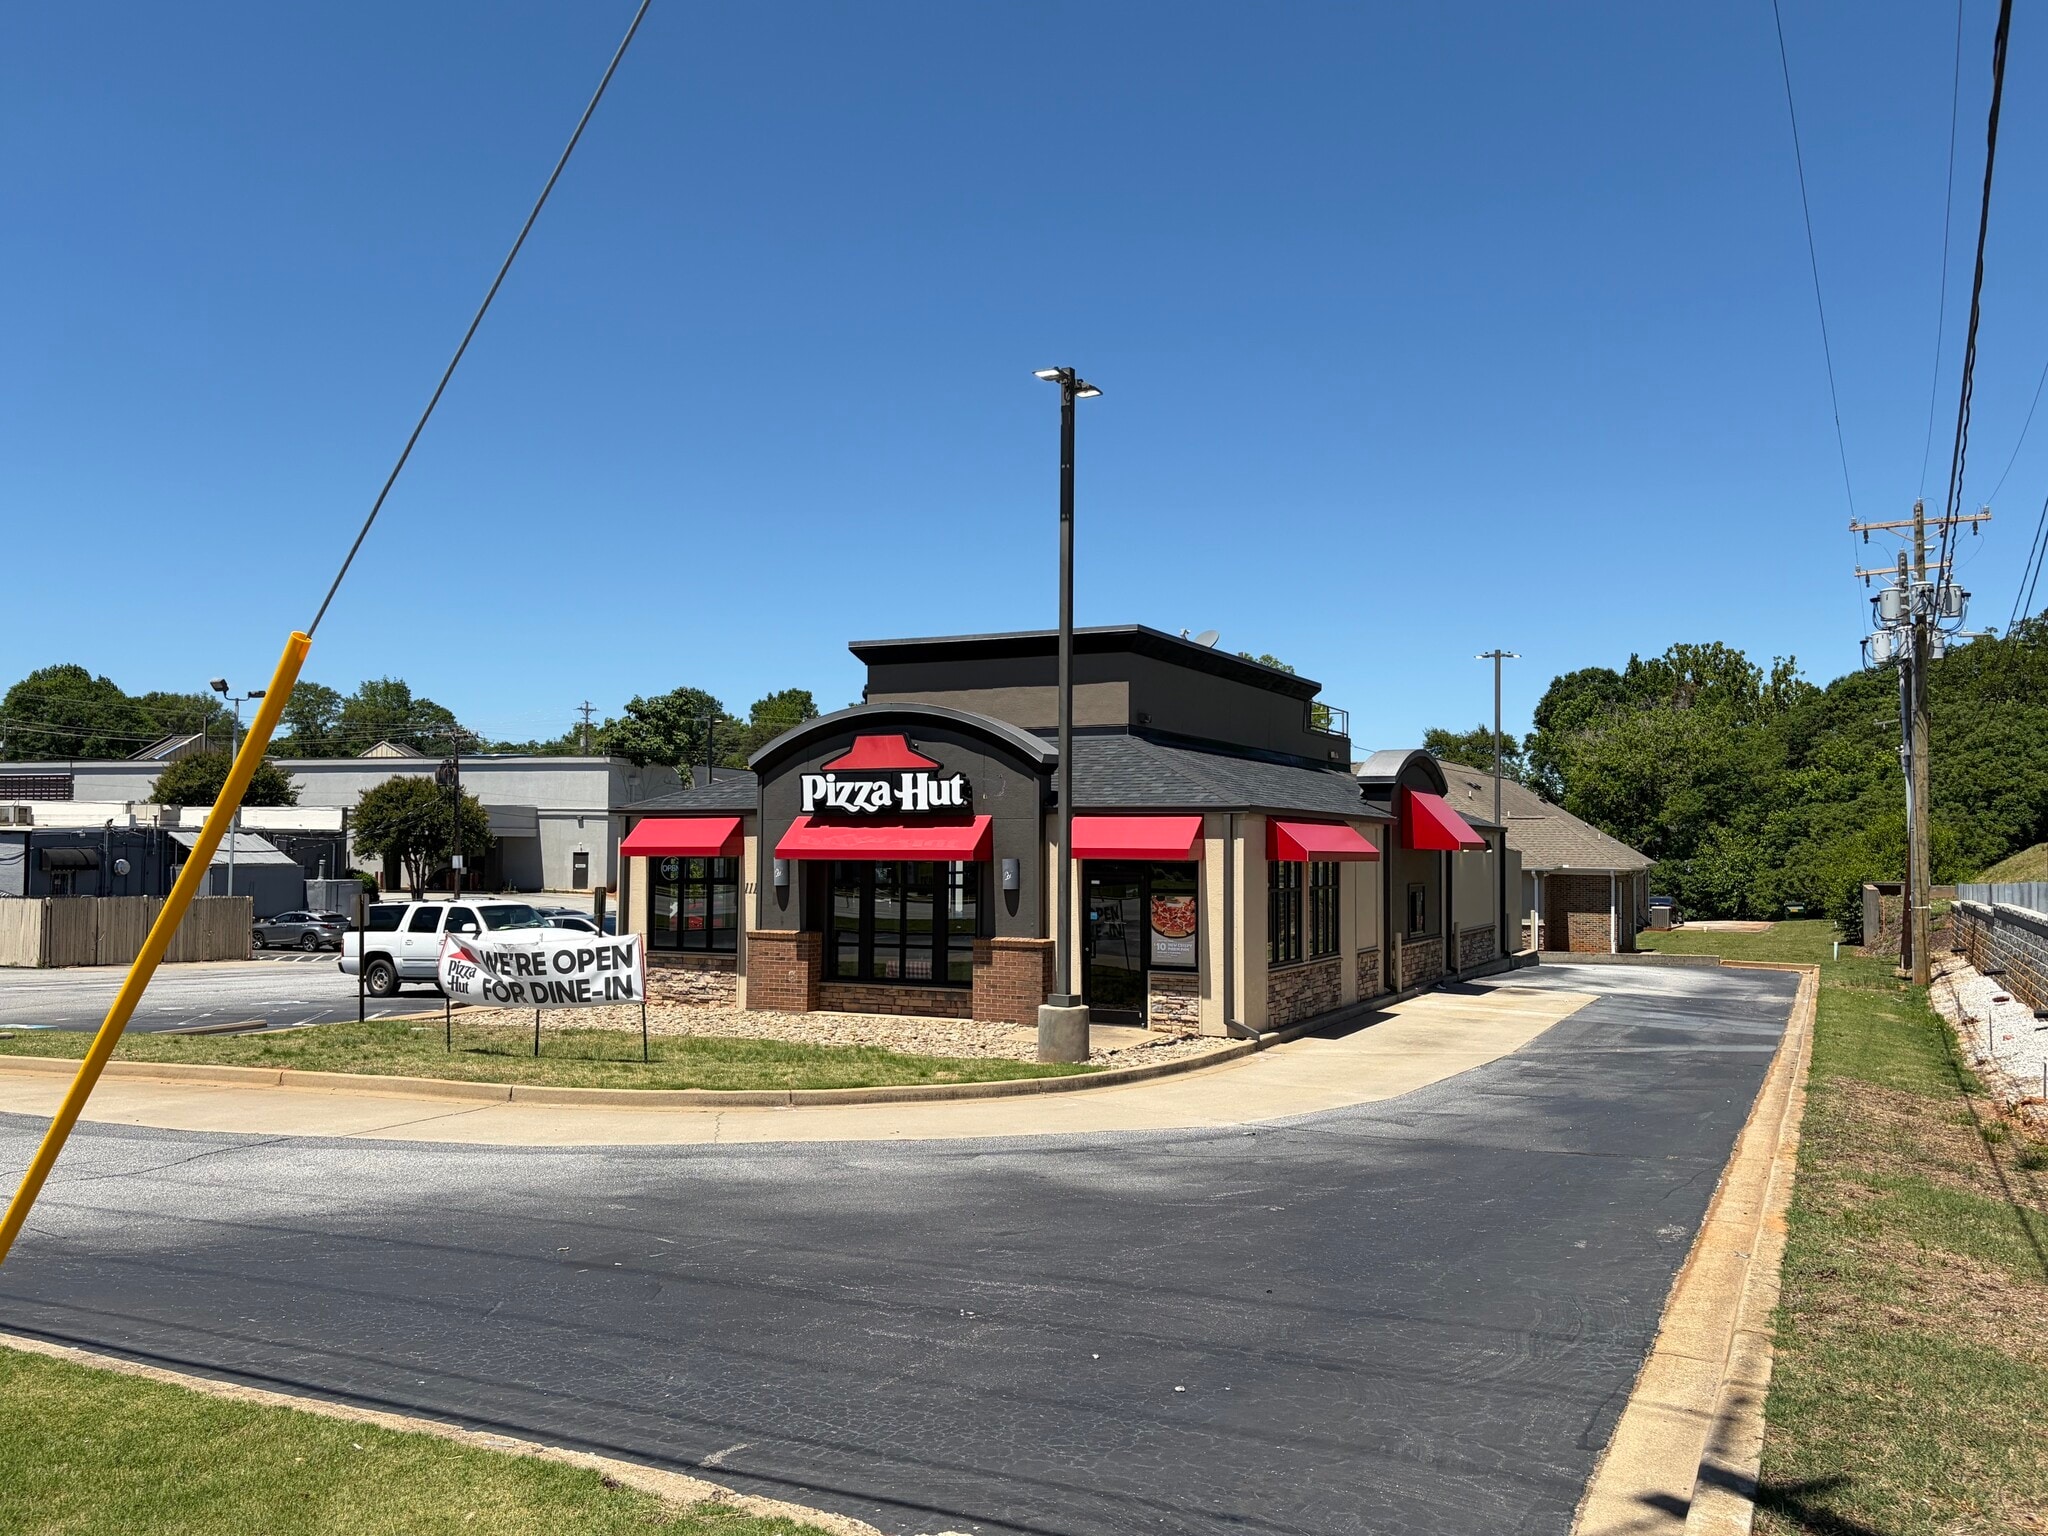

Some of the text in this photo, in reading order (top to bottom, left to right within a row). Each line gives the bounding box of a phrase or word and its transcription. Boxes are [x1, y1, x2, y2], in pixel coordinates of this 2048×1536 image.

[801, 772, 964, 812] Pizza Hut
[662, 865, 680, 873] OPEN
[447, 960, 478, 980] Pizza
[479, 944, 634, 977] WE'RE OPEN
[447, 975, 470, 995] Hut
[482, 974, 634, 1004] FOR DINE-IN
